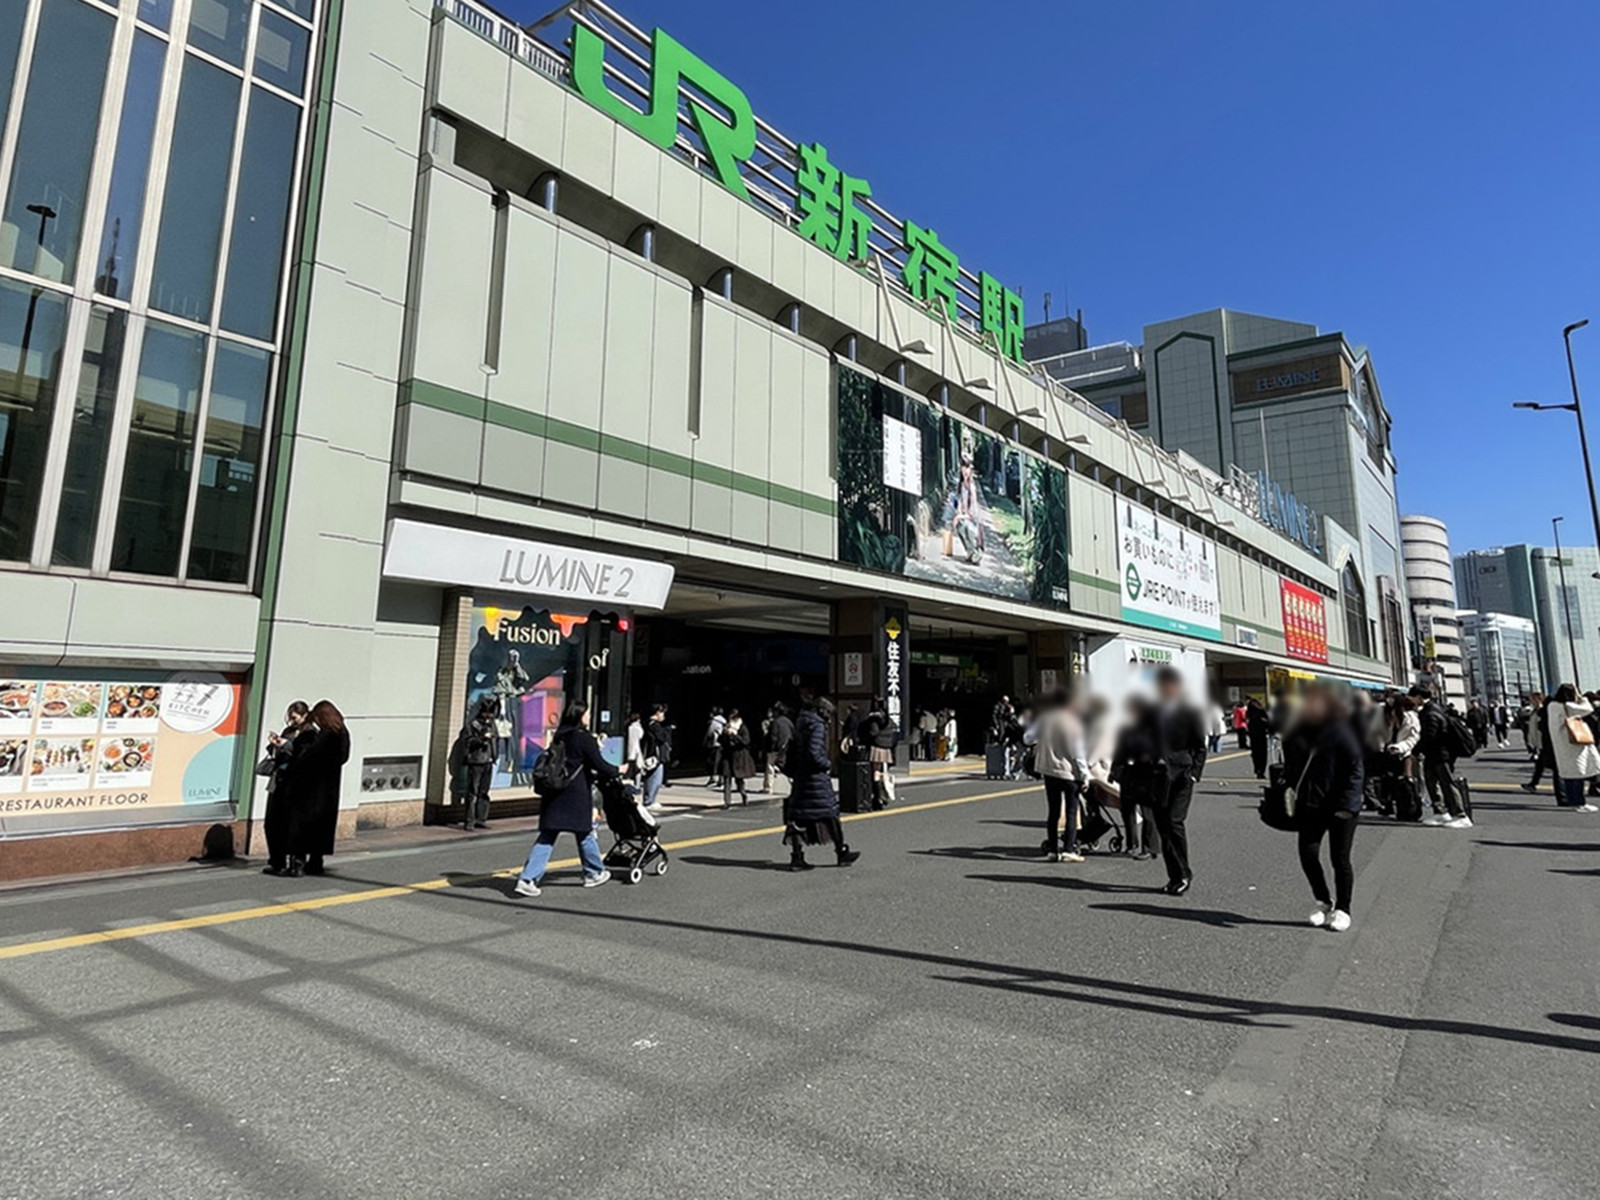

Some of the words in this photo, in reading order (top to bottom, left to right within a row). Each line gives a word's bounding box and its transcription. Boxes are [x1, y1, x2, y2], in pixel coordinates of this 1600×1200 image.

[572, 24, 756, 203] JR
[796, 142, 1025, 367] 新宿駅
[500, 549, 614, 595] LUMINE
[614, 567, 635, 598] 2
[1161, 584, 1187, 608] POINT
[494, 620, 561, 645] Fusion
[590, 648, 609, 669] of
[0, 795, 94, 811] RESTAURANT
[100, 793, 149, 806] FLOOR
